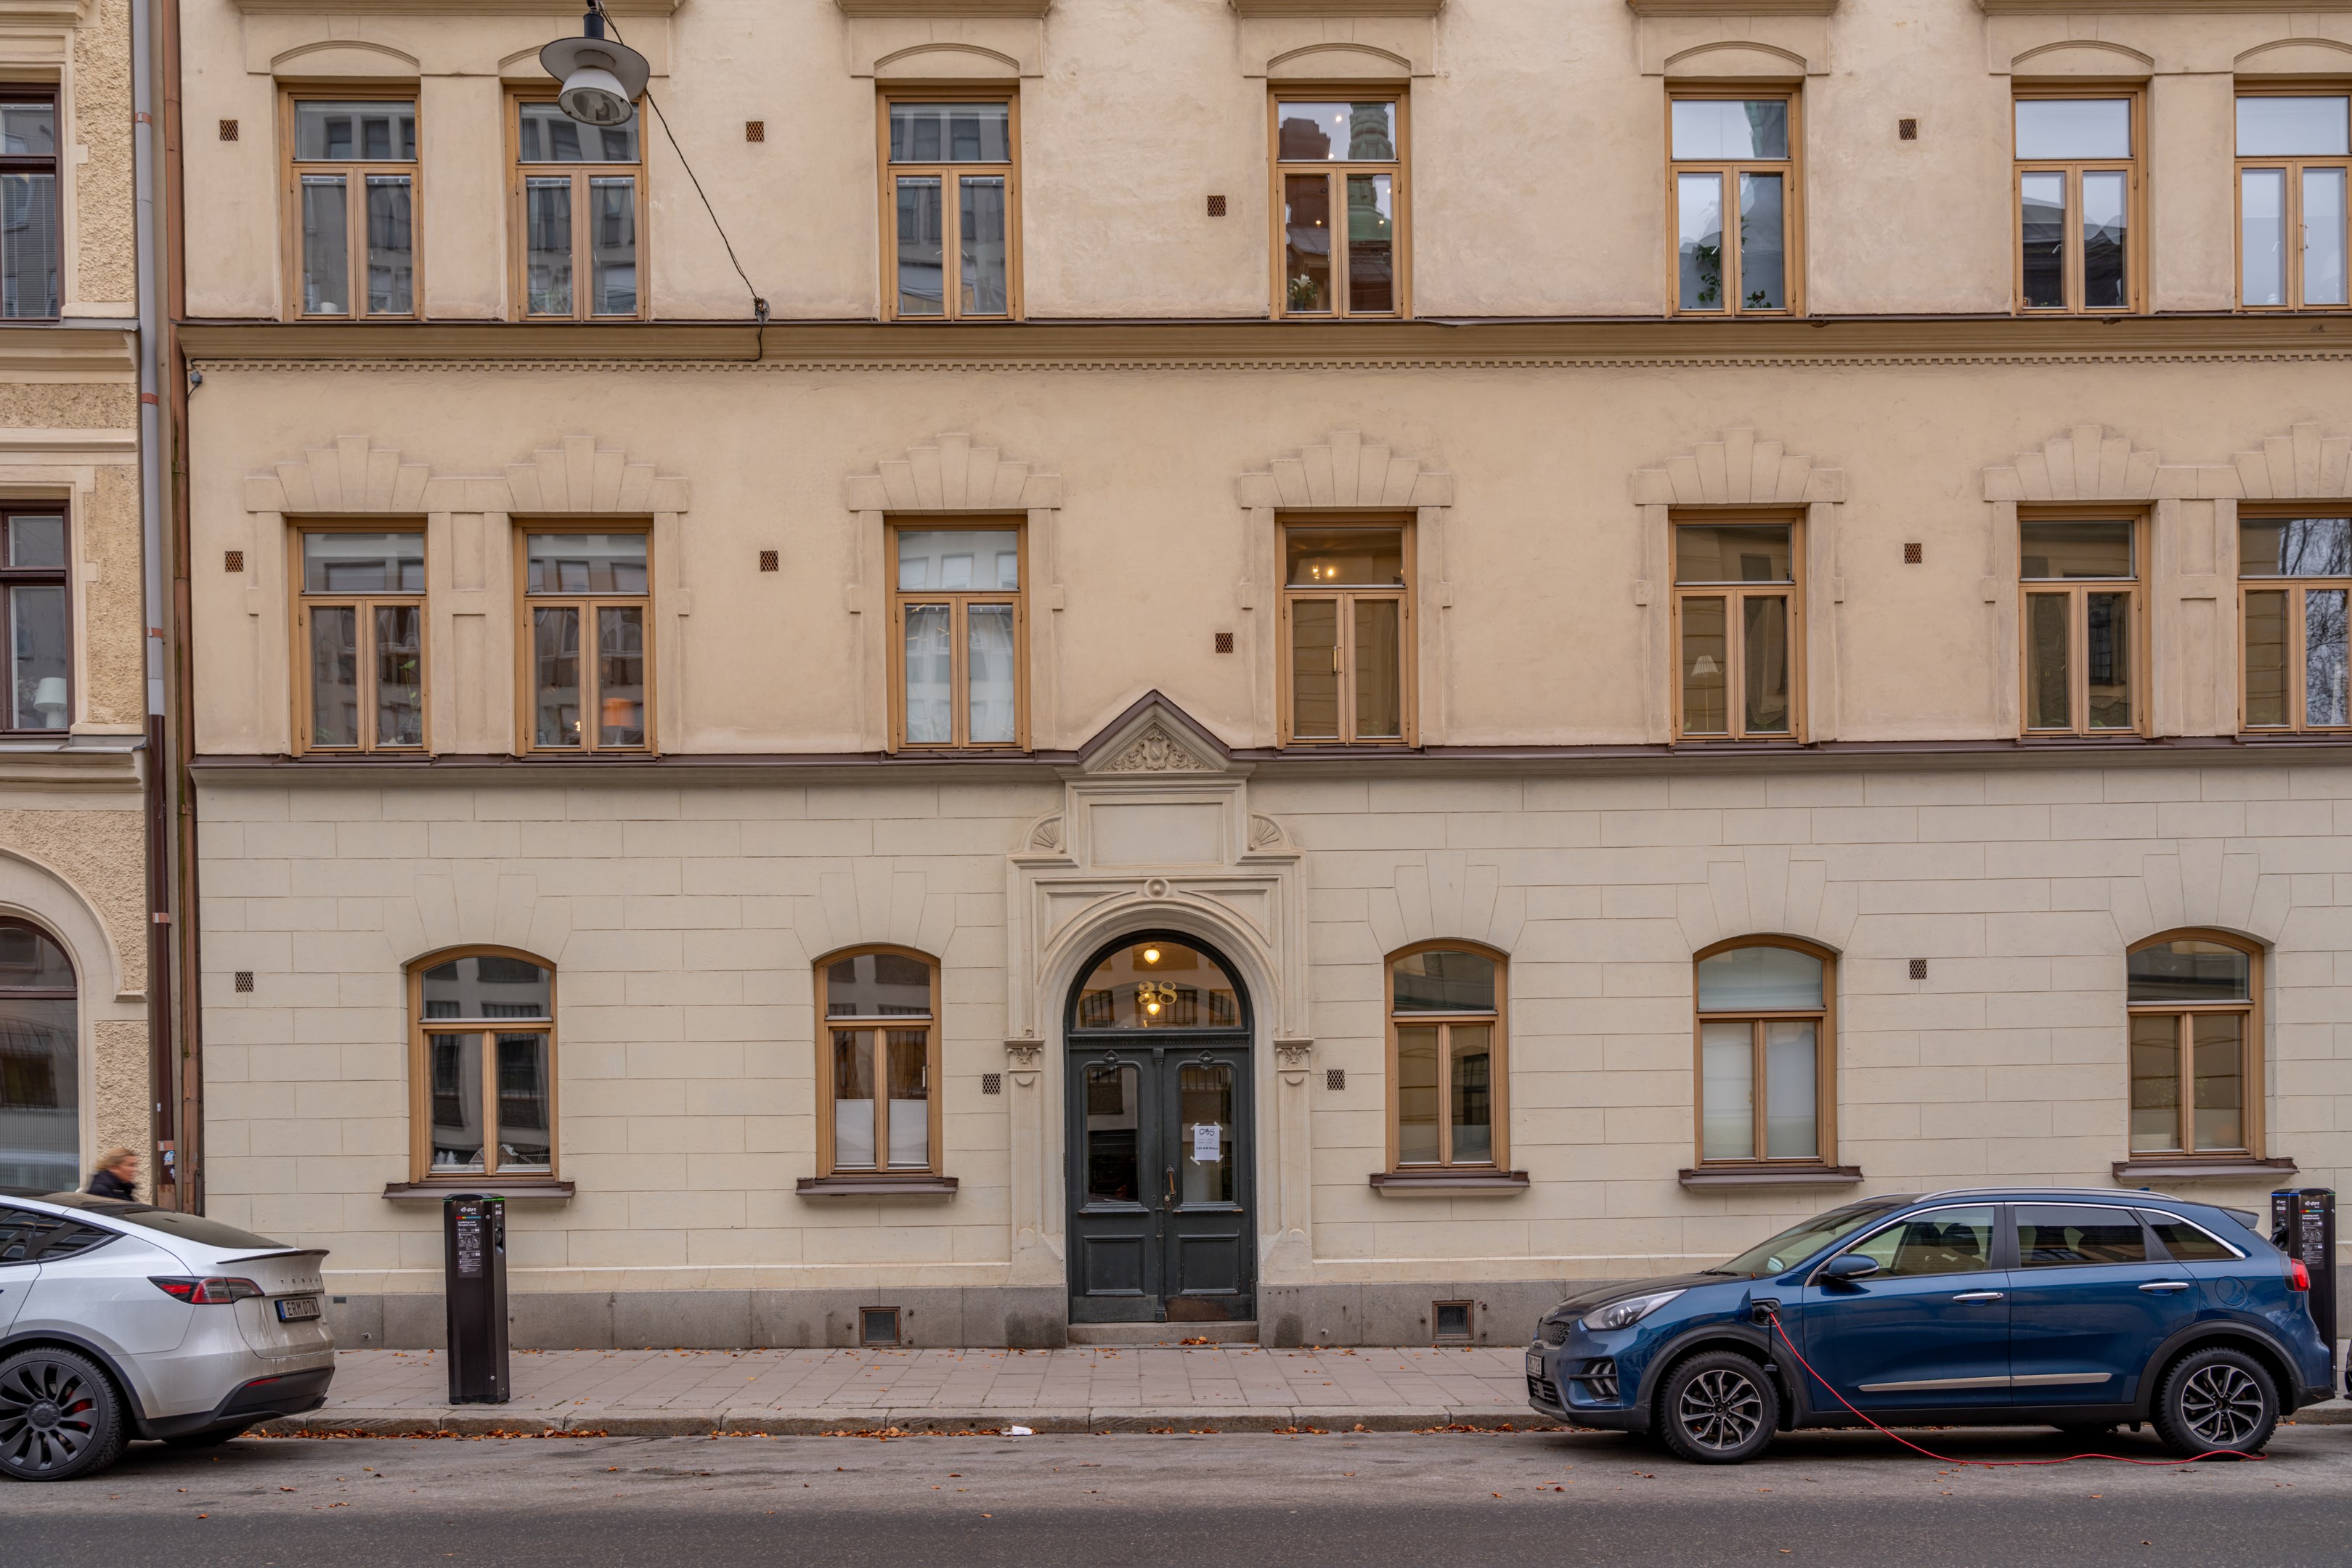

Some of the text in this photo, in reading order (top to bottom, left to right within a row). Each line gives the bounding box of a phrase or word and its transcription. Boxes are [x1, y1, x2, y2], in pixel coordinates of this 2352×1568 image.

[1138, 981, 1178, 1005] 38
[1199, 1128, 1215, 1137] OBS
[286, 1300, 317, 1316] ERM 07N
[1676, 1360, 1705, 1384] NEXEN
